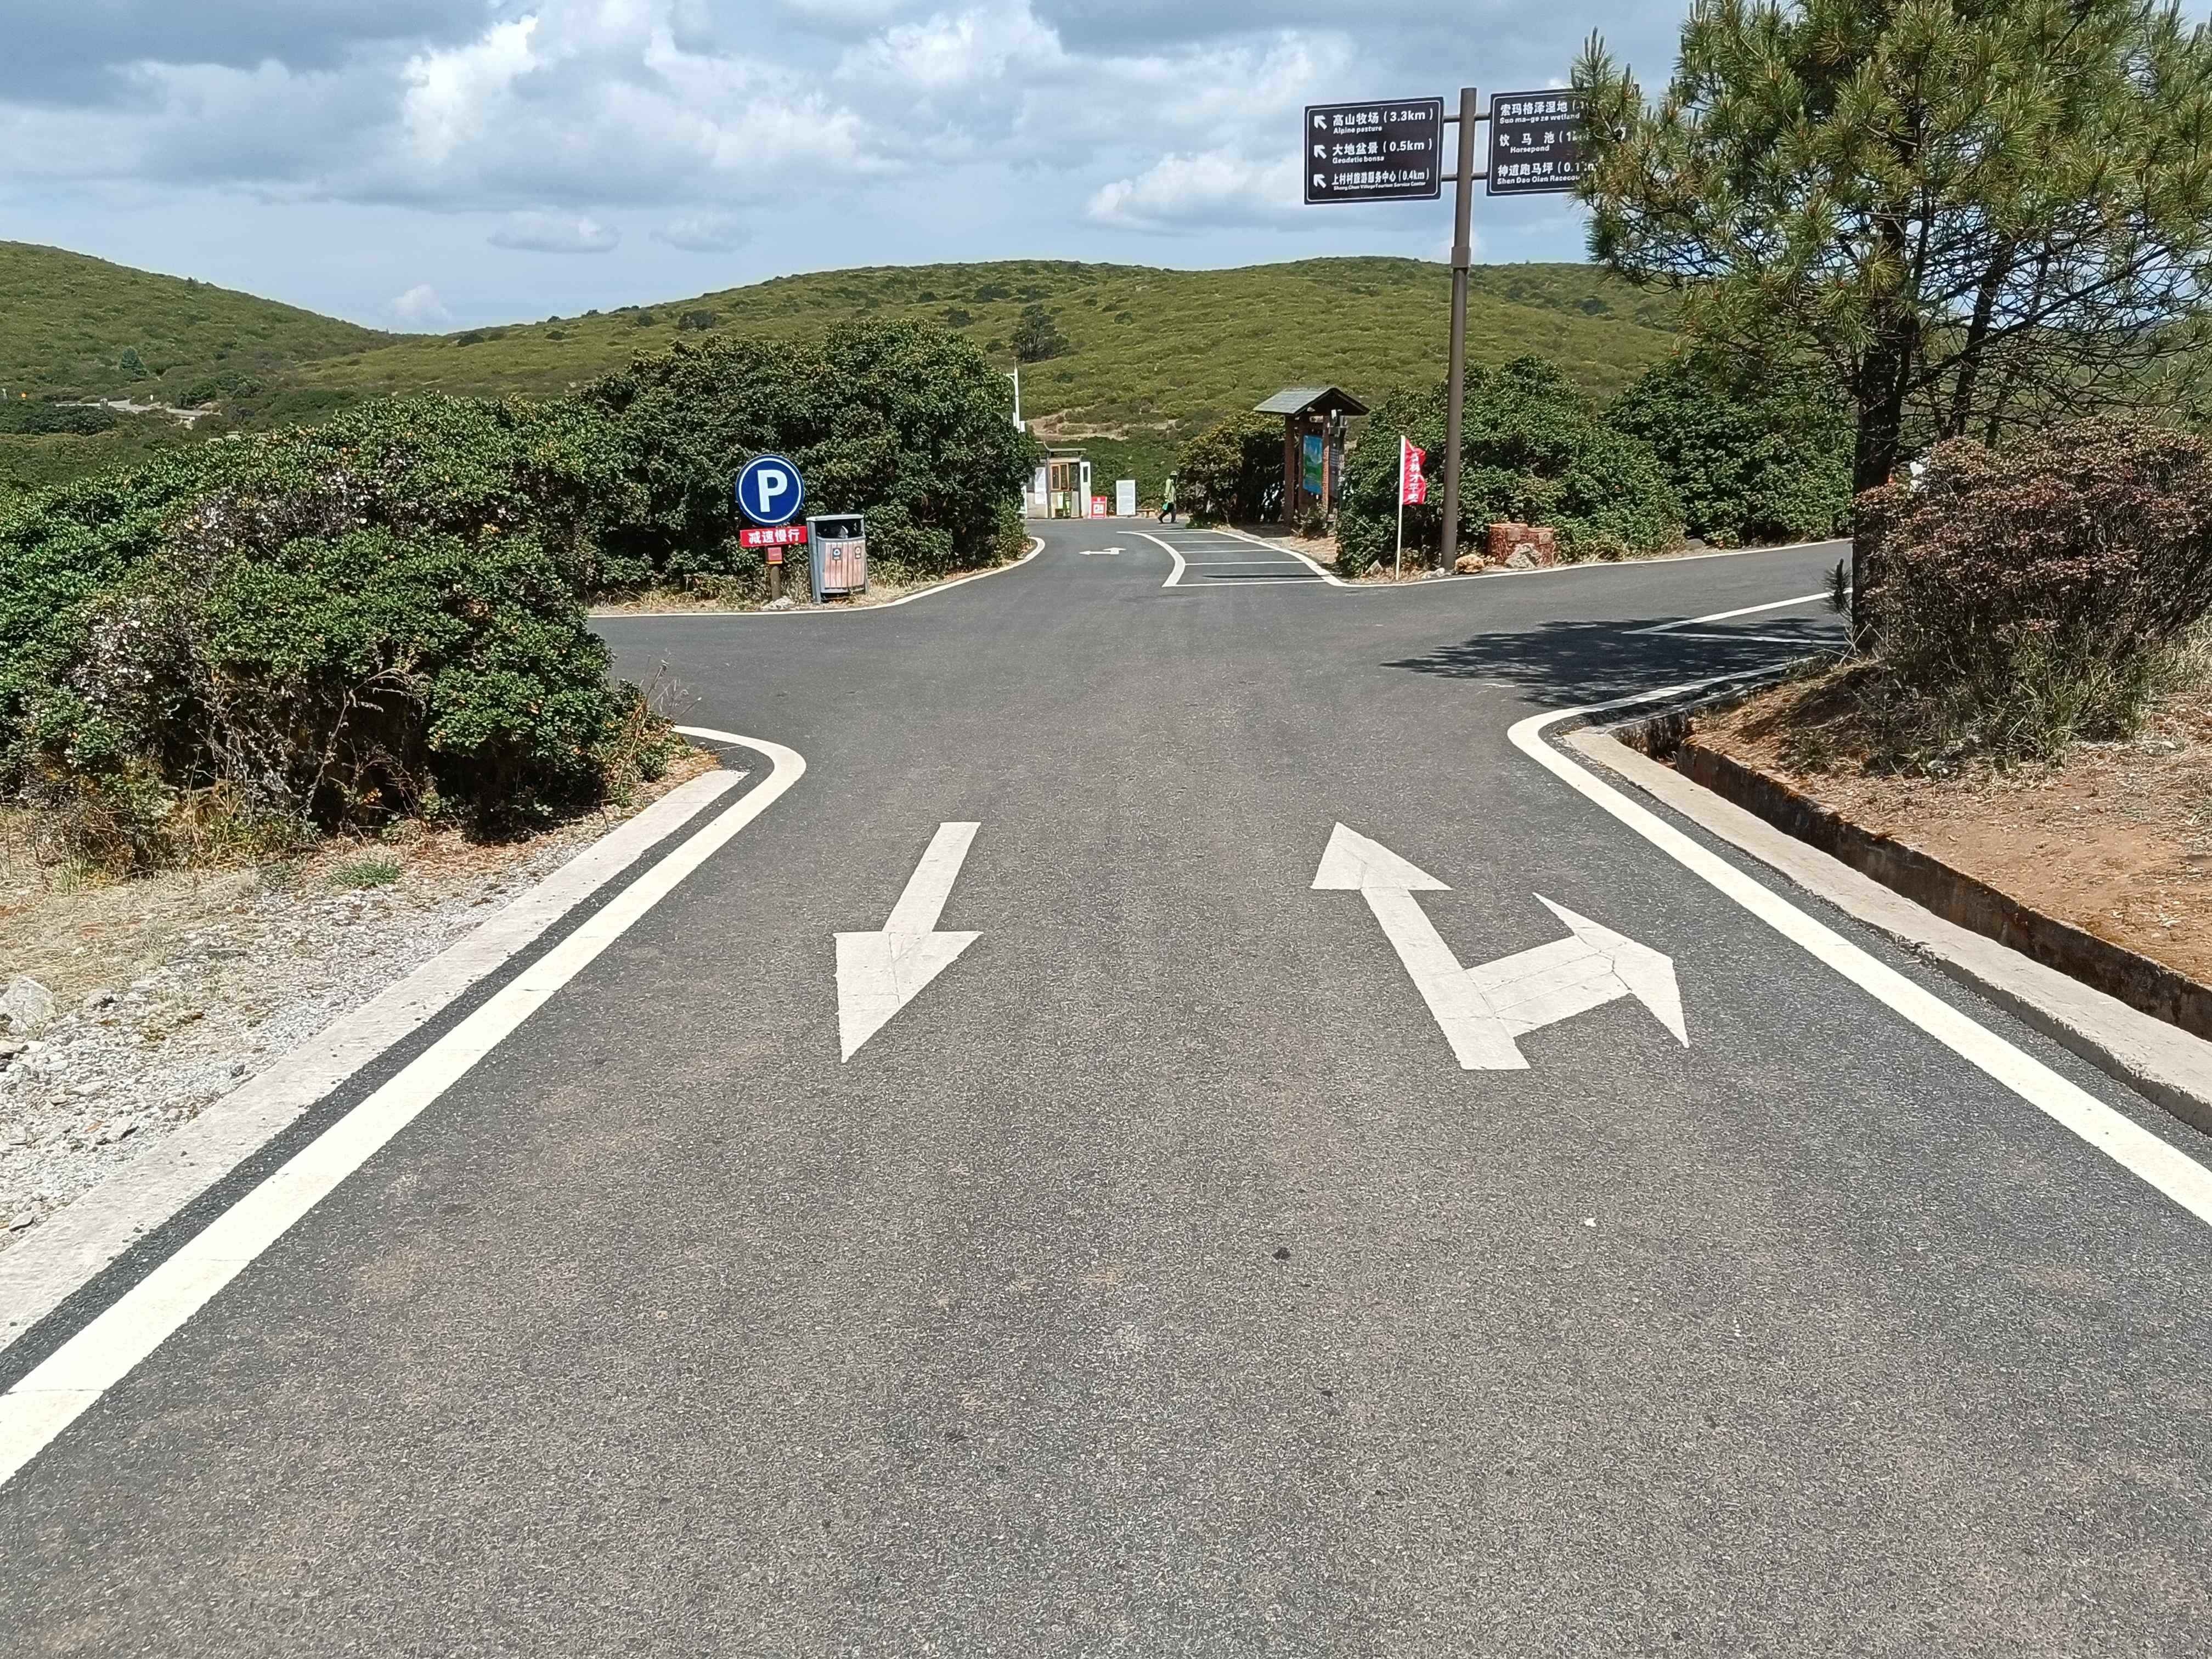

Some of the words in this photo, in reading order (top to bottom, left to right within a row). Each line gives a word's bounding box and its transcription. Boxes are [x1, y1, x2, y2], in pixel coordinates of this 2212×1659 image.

[1356, 126, 1383, 134] pasture
[1510, 145, 1550, 154] Horsepond
[757, 470, 788, 512] P
[748, 528, 800, 544] 减速慢行
